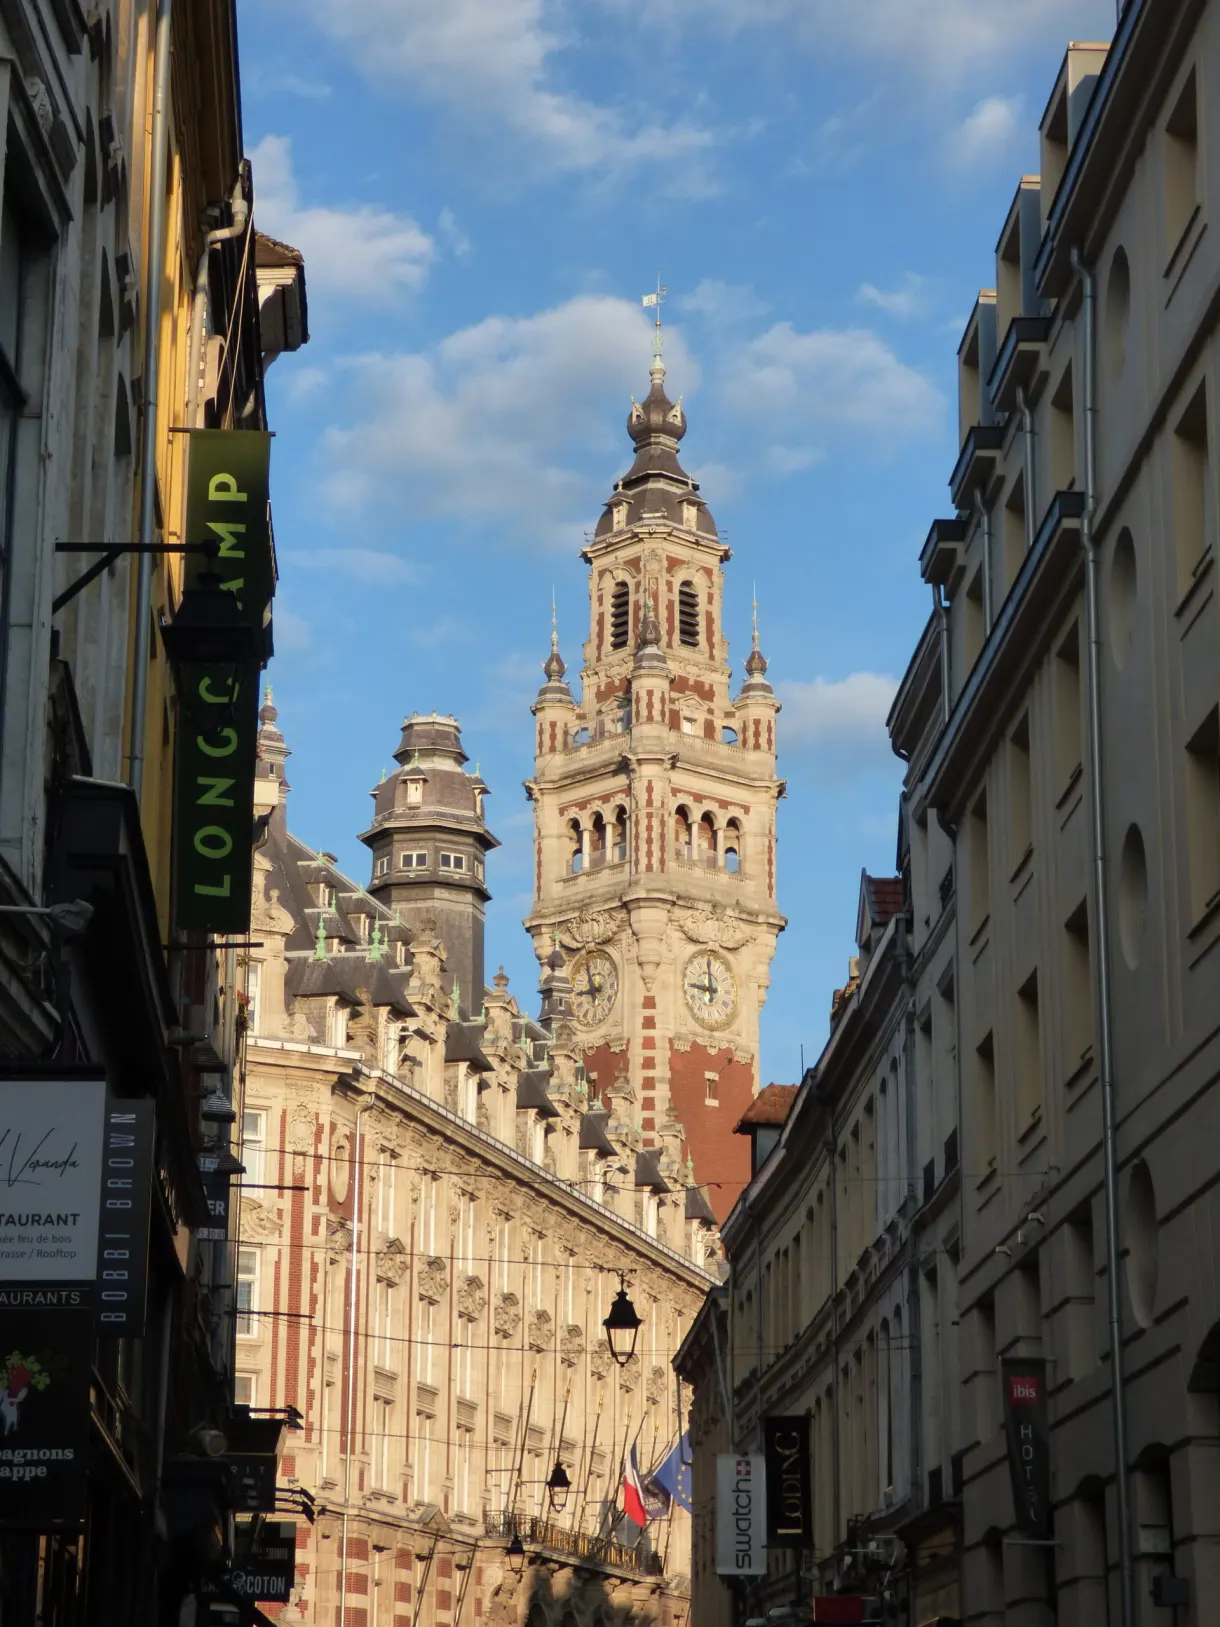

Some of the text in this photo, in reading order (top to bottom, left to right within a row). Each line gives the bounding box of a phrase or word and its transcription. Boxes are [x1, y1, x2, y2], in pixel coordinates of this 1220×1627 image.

[194, 472, 249, 898] LONGCMP
[101, 1112, 137, 1322] BOBBI BROWN
[17, 1234, 34, 1244] feu
[36, 1234, 49, 1244] de
[51, 1234, 72, 1244] bois
[36, 1248, 77, 1261] Rooftop
[1013, 1384, 1037, 1399] ibis
[0, 1446, 76, 1465] agnons
[773, 1431, 804, 1536] LODING
[731, 1478, 752, 1569] swatch
[246, 1575, 286, 1594] COTON
